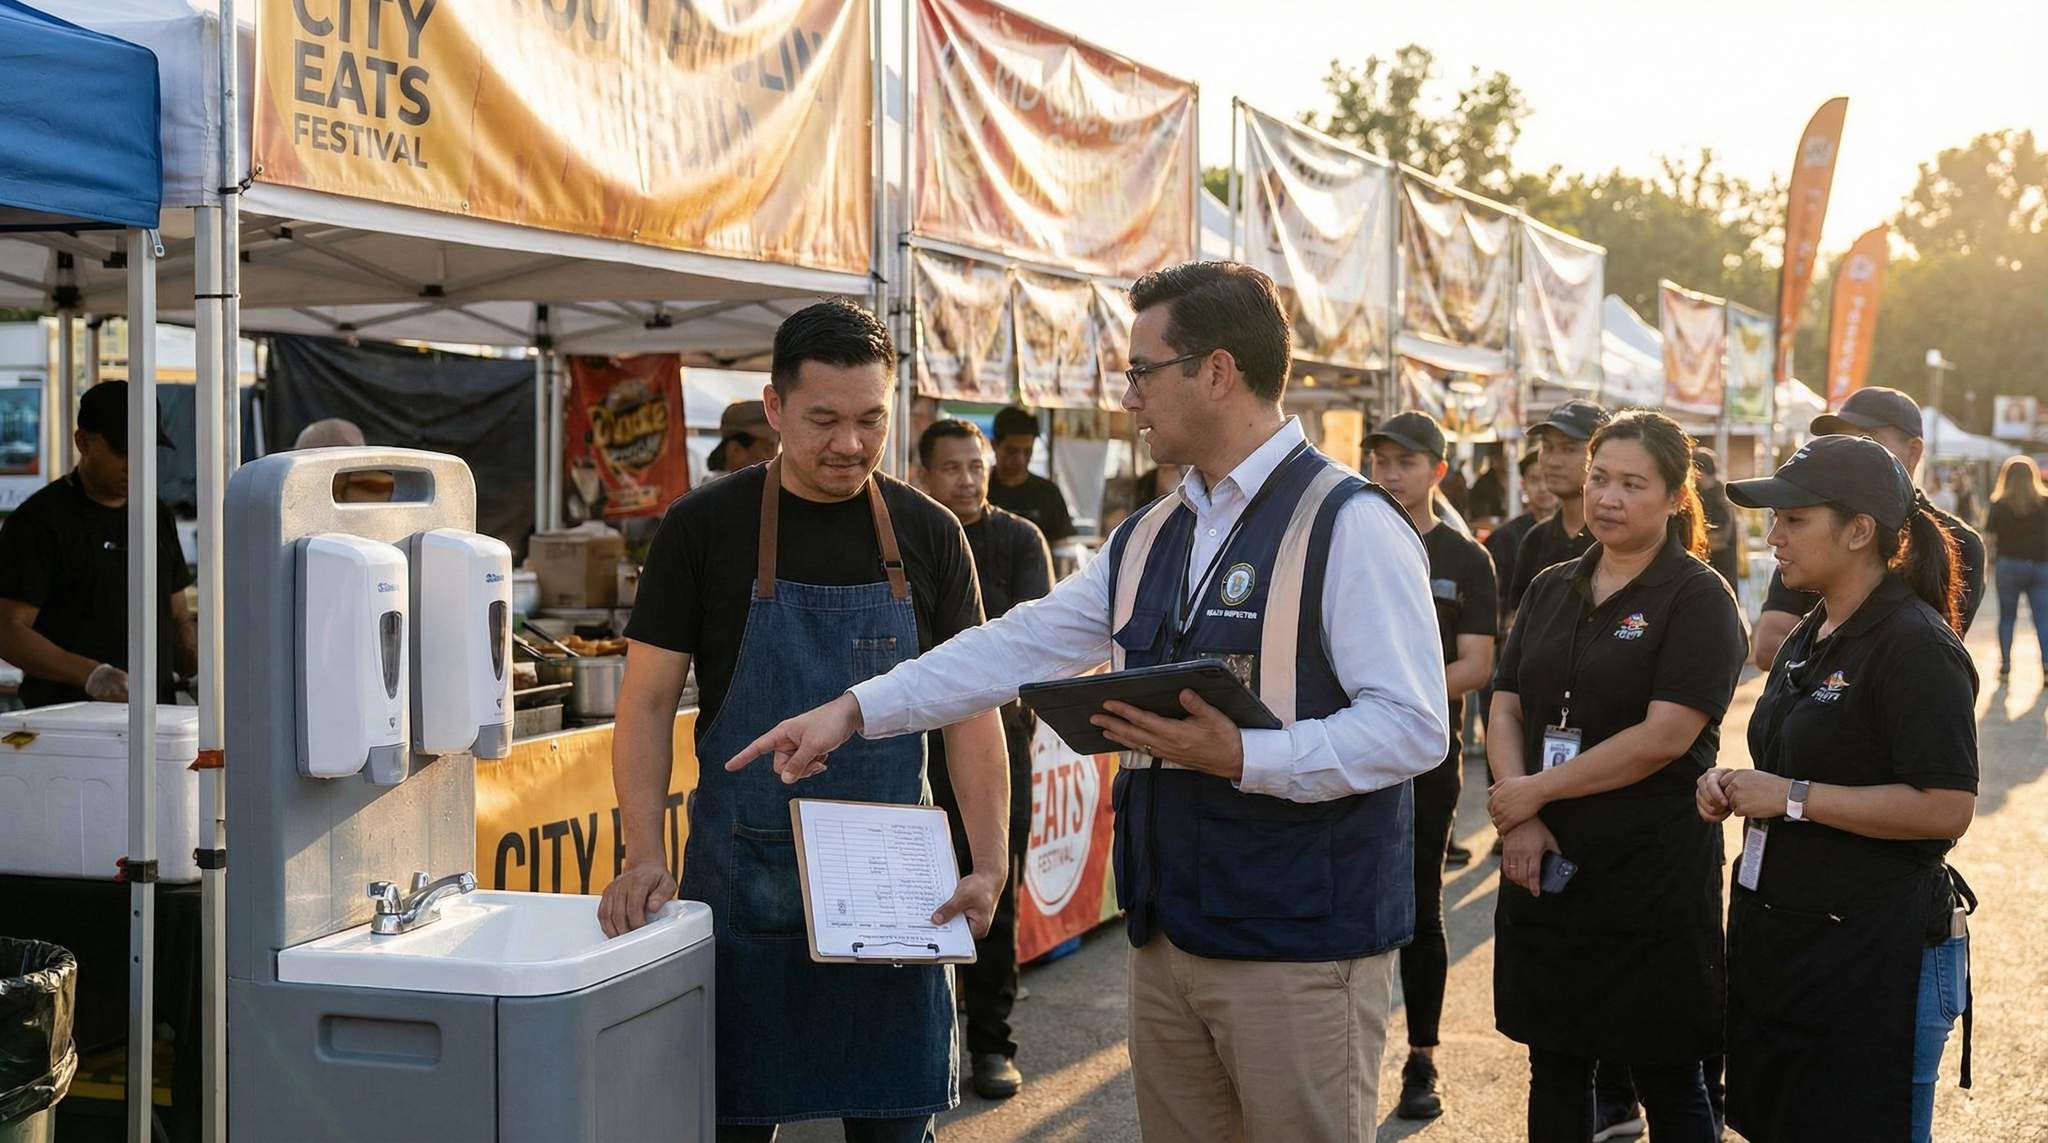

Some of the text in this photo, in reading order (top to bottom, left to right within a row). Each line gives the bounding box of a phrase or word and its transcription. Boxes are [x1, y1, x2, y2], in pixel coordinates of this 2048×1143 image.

[292, 0, 437, 59] CITY
[294, 38, 431, 126] EATS
[294, 112, 428, 169] FESTIVAL
[1030, 760, 1085, 850] EATS
[494, 812, 598, 895] CITY
